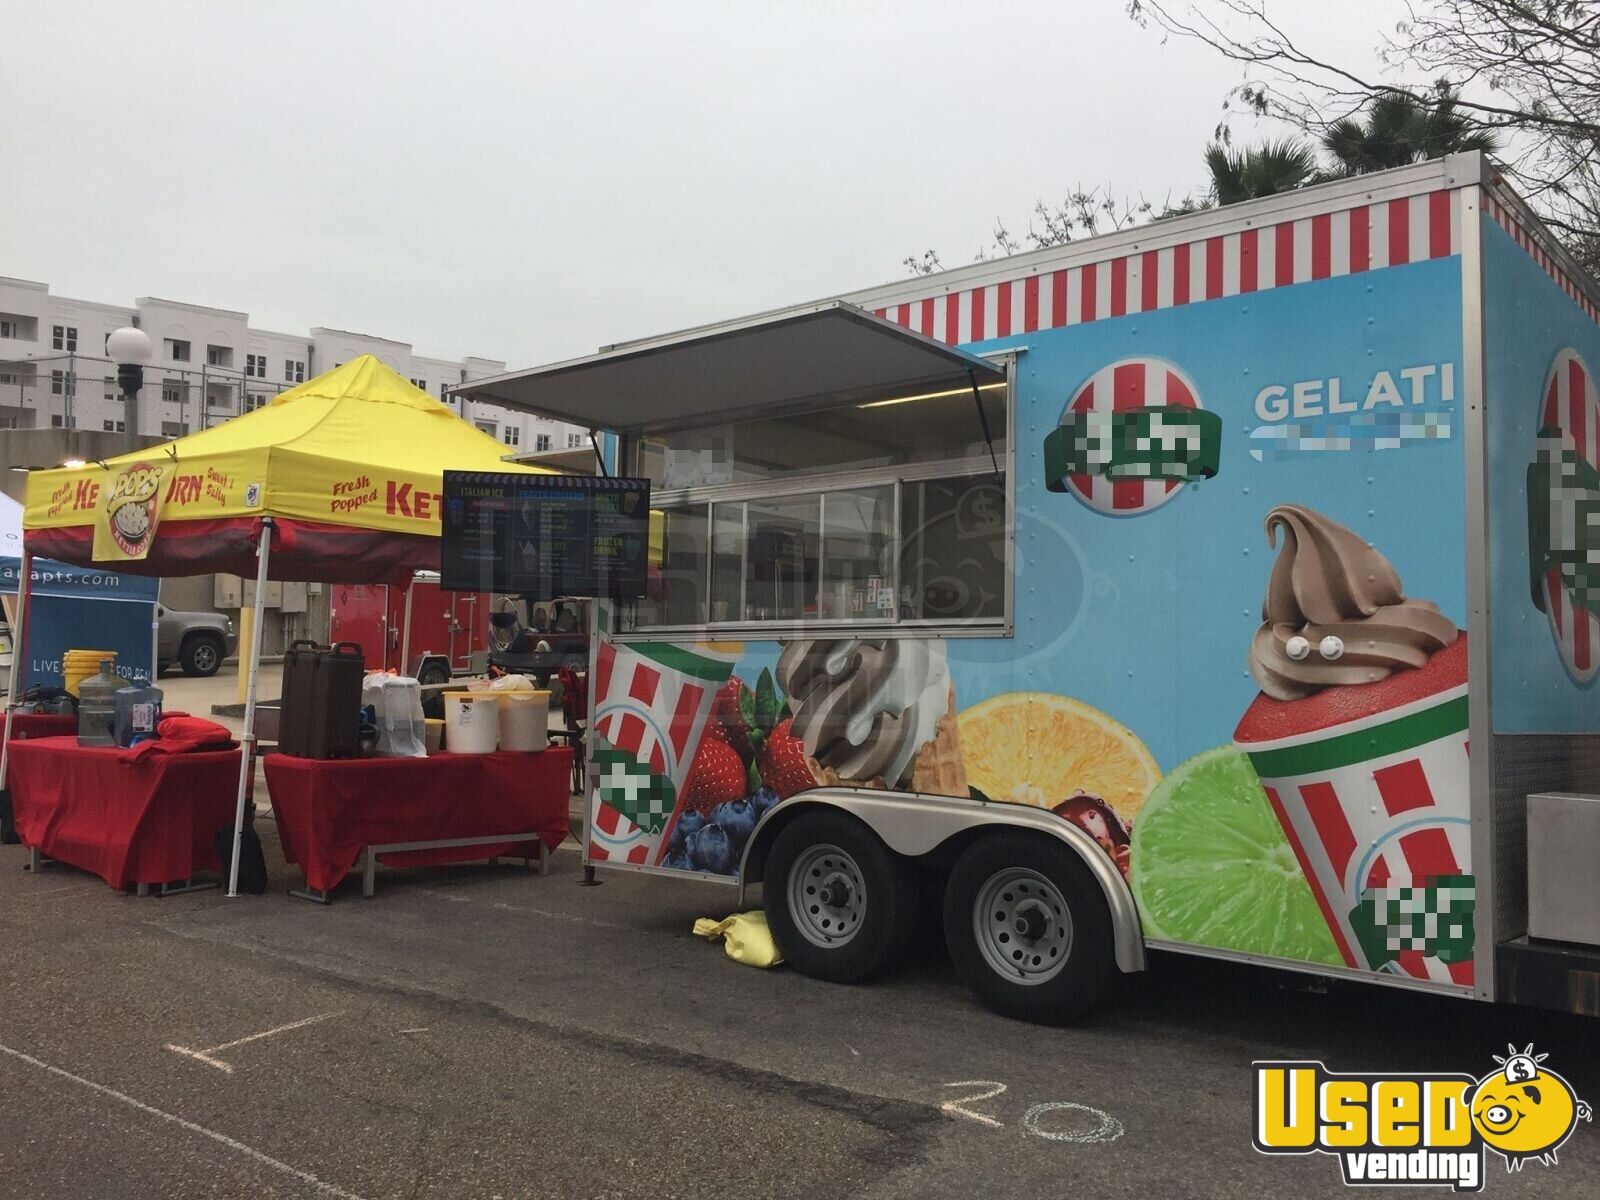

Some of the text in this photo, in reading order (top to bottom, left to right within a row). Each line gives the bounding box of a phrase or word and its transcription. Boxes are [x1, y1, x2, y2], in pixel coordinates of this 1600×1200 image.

[1254, 362, 1455, 422] GELATI
[333, 475, 371, 496] Fresh
[461, 487, 505, 498] ITALIAN ICE
[331, 489, 377, 513] Popped
[33, 660, 60, 673] LIVE
[116, 665, 132, 679] FOR
